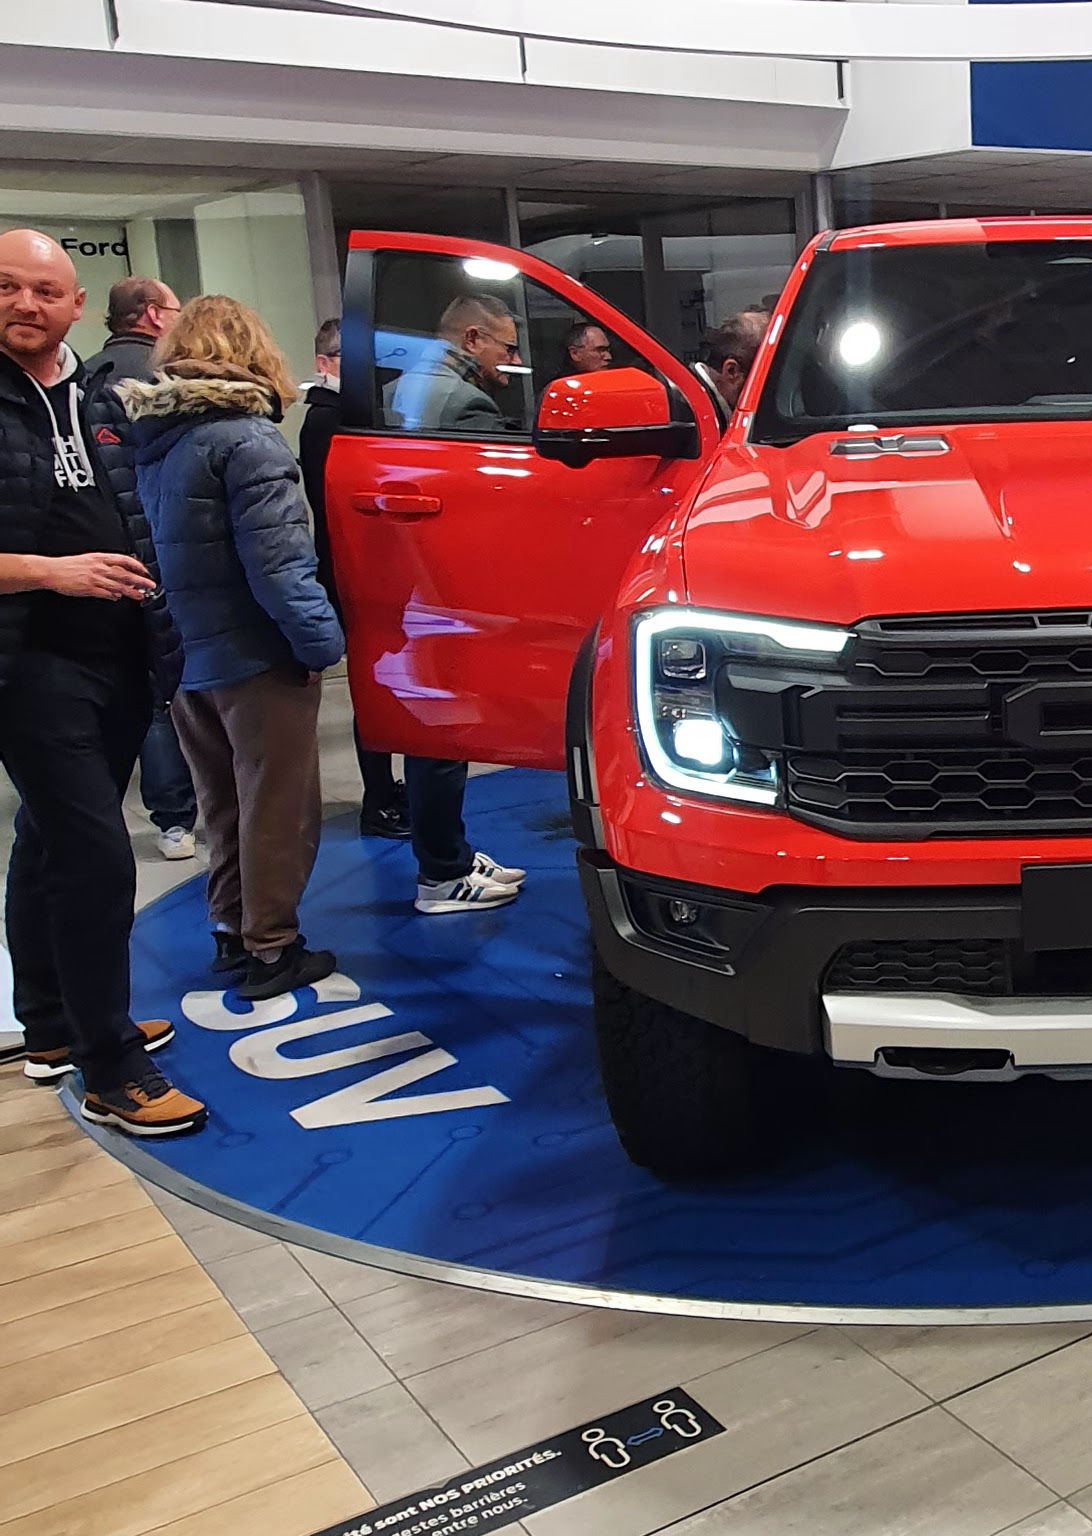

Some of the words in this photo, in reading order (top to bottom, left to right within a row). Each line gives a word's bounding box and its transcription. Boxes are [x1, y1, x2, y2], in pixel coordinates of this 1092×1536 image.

[60, 237, 128, 256] Ford
[180, 971, 512, 1130] SUV
[374, 1506, 419, 1530] sont
[418, 1488, 461, 1512] NOS
[460, 1449, 563, 1495] PRIORITÉS.
[449, 1481, 527, 1519] barrières
[480, 1496, 529, 1520] nous.
